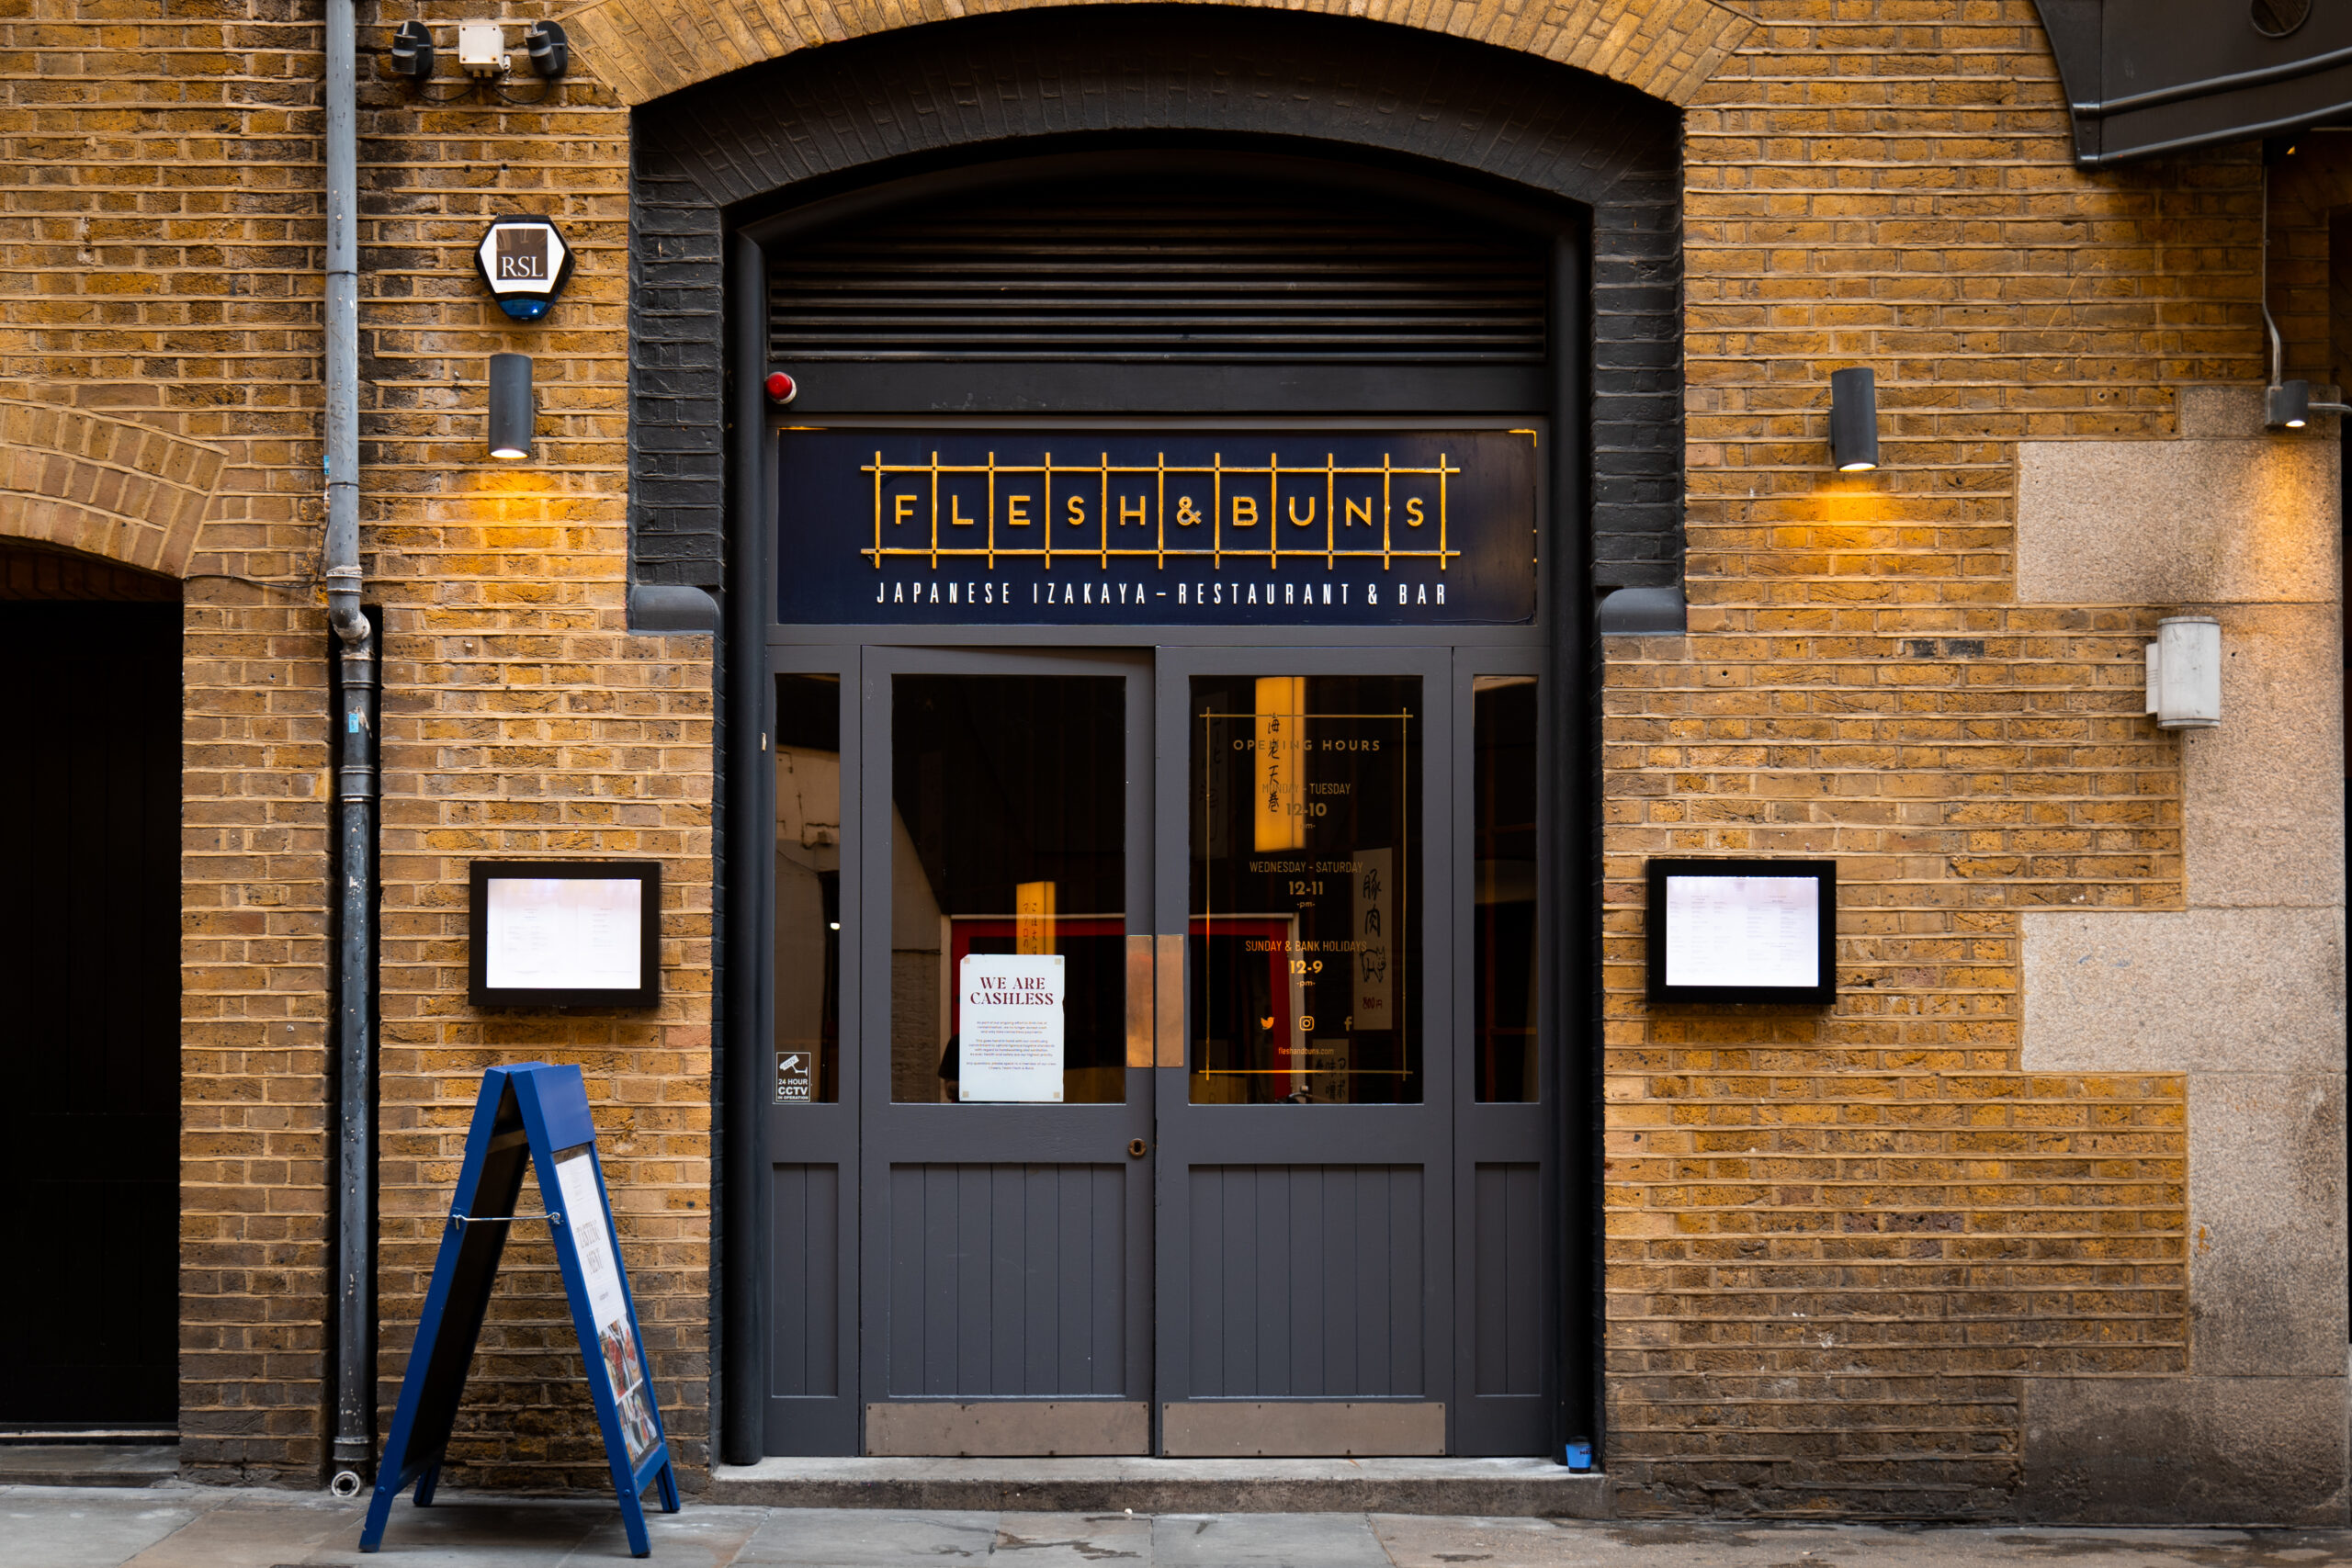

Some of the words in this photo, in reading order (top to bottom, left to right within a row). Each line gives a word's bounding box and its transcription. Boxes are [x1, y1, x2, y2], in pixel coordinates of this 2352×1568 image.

[502, 256, 544, 276] RSL
[895, 495, 1147, 525] FLESH
[1177, 496, 1202, 525] &
[1233, 496, 1425, 525] BUNS
[876, 582, 1010, 604] JAPANESE
[1368, 583, 1377, 604] &
[1398, 583, 1445, 604] BAR
[1323, 740, 1380, 751] HOURS
[1309, 784, 1351, 795] TUESDAY
[1286, 803, 1328, 817] 12-10
[1250, 862, 1306, 873] WEDNESDAY
[1316, 862, 1363, 873] SATURDAY
[1288, 881, 1323, 895] 12-11
[1245, 941, 1282, 952] SUNDAY
[1285, 941, 1292, 952] &
[1295, 941, 1320, 952] BANK
[1323, 941, 1367, 952] HOLIDAYS
[1290, 960, 1323, 974] 12-9
[979, 977, 1007, 989] WE
[1012, 977, 1046, 989] ARE
[970, 992, 1054, 1005] CASHLESS
[778, 1086, 808, 1095] CCTV
